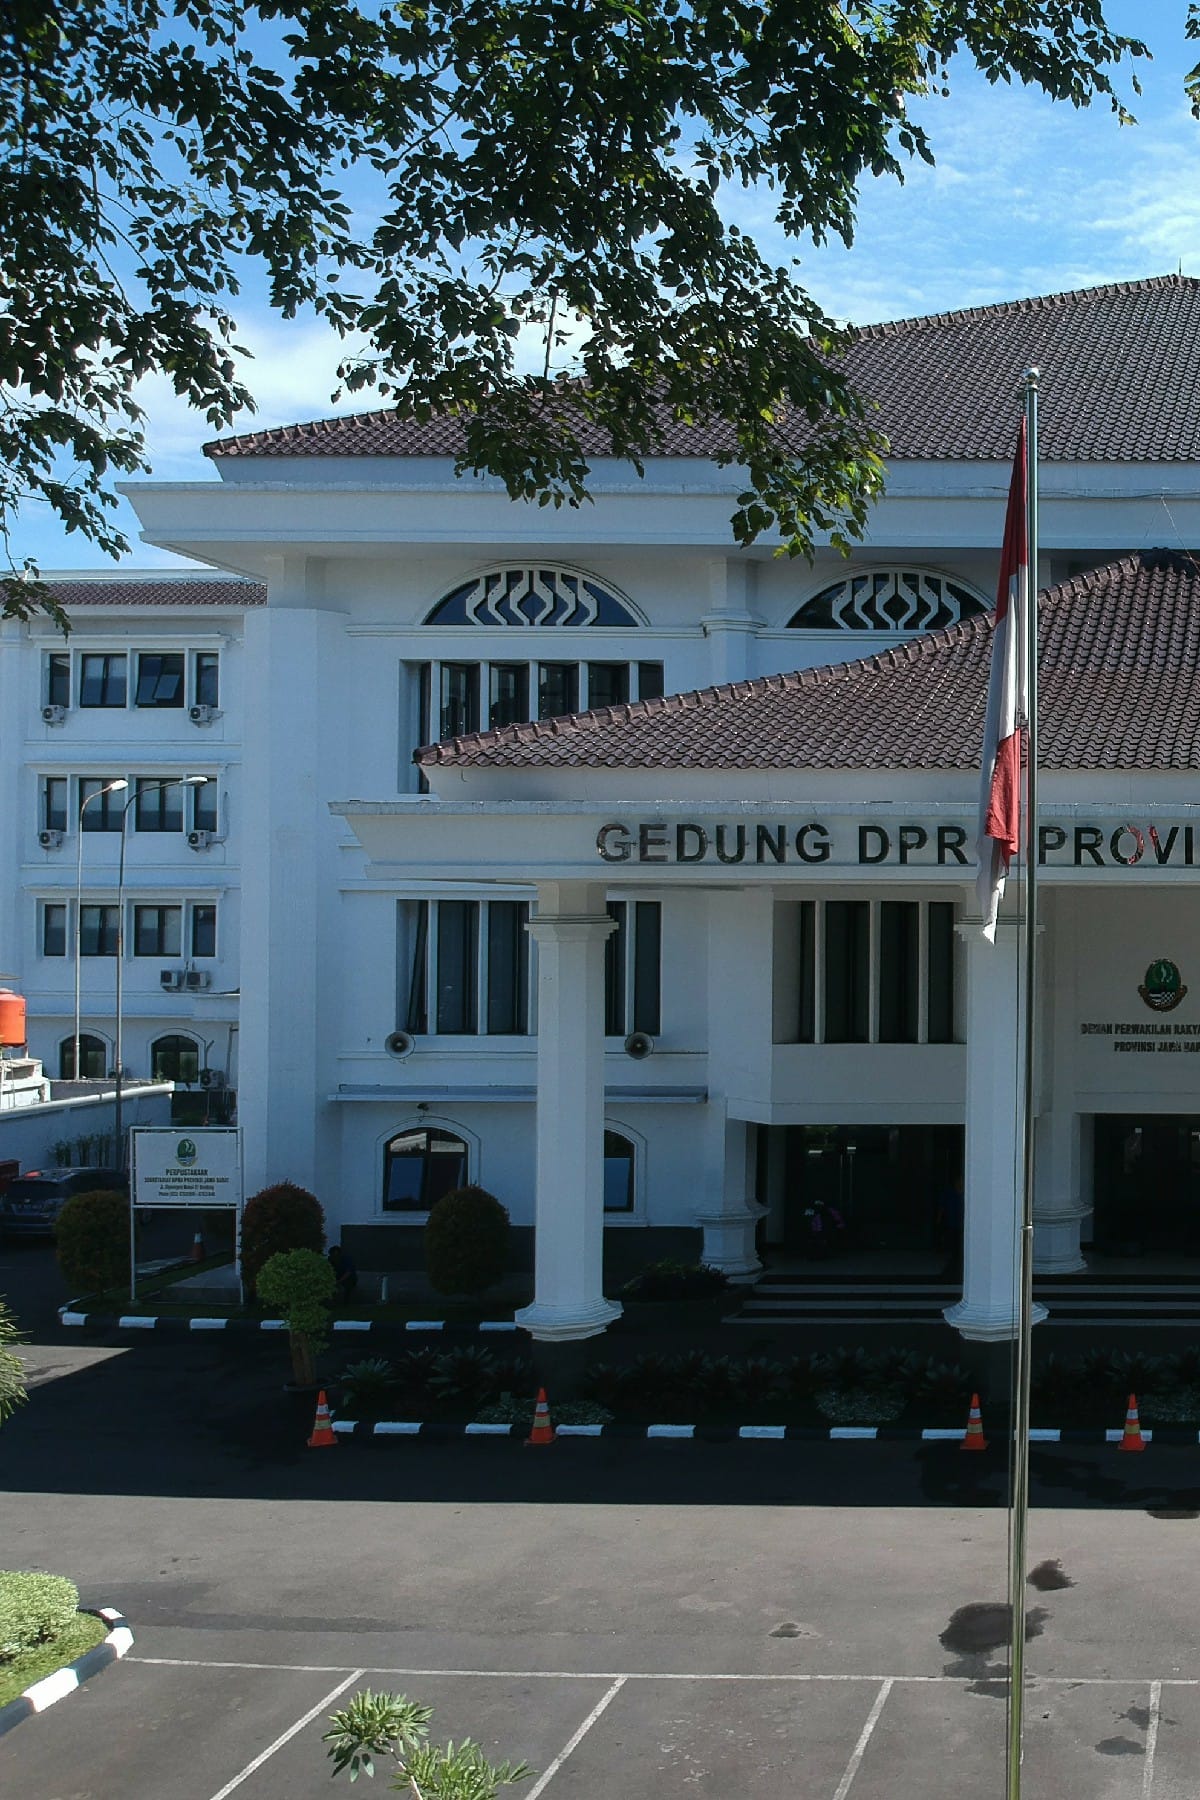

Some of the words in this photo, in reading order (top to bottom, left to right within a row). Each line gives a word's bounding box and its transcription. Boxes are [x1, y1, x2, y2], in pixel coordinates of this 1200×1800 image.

[596, 823, 830, 865] GEDUNG
[858, 824, 986, 867] DPR
[1114, 1024, 1172, 1035] PERWAKILAN
[1114, 1041, 1156, 1053] PROVINSI
